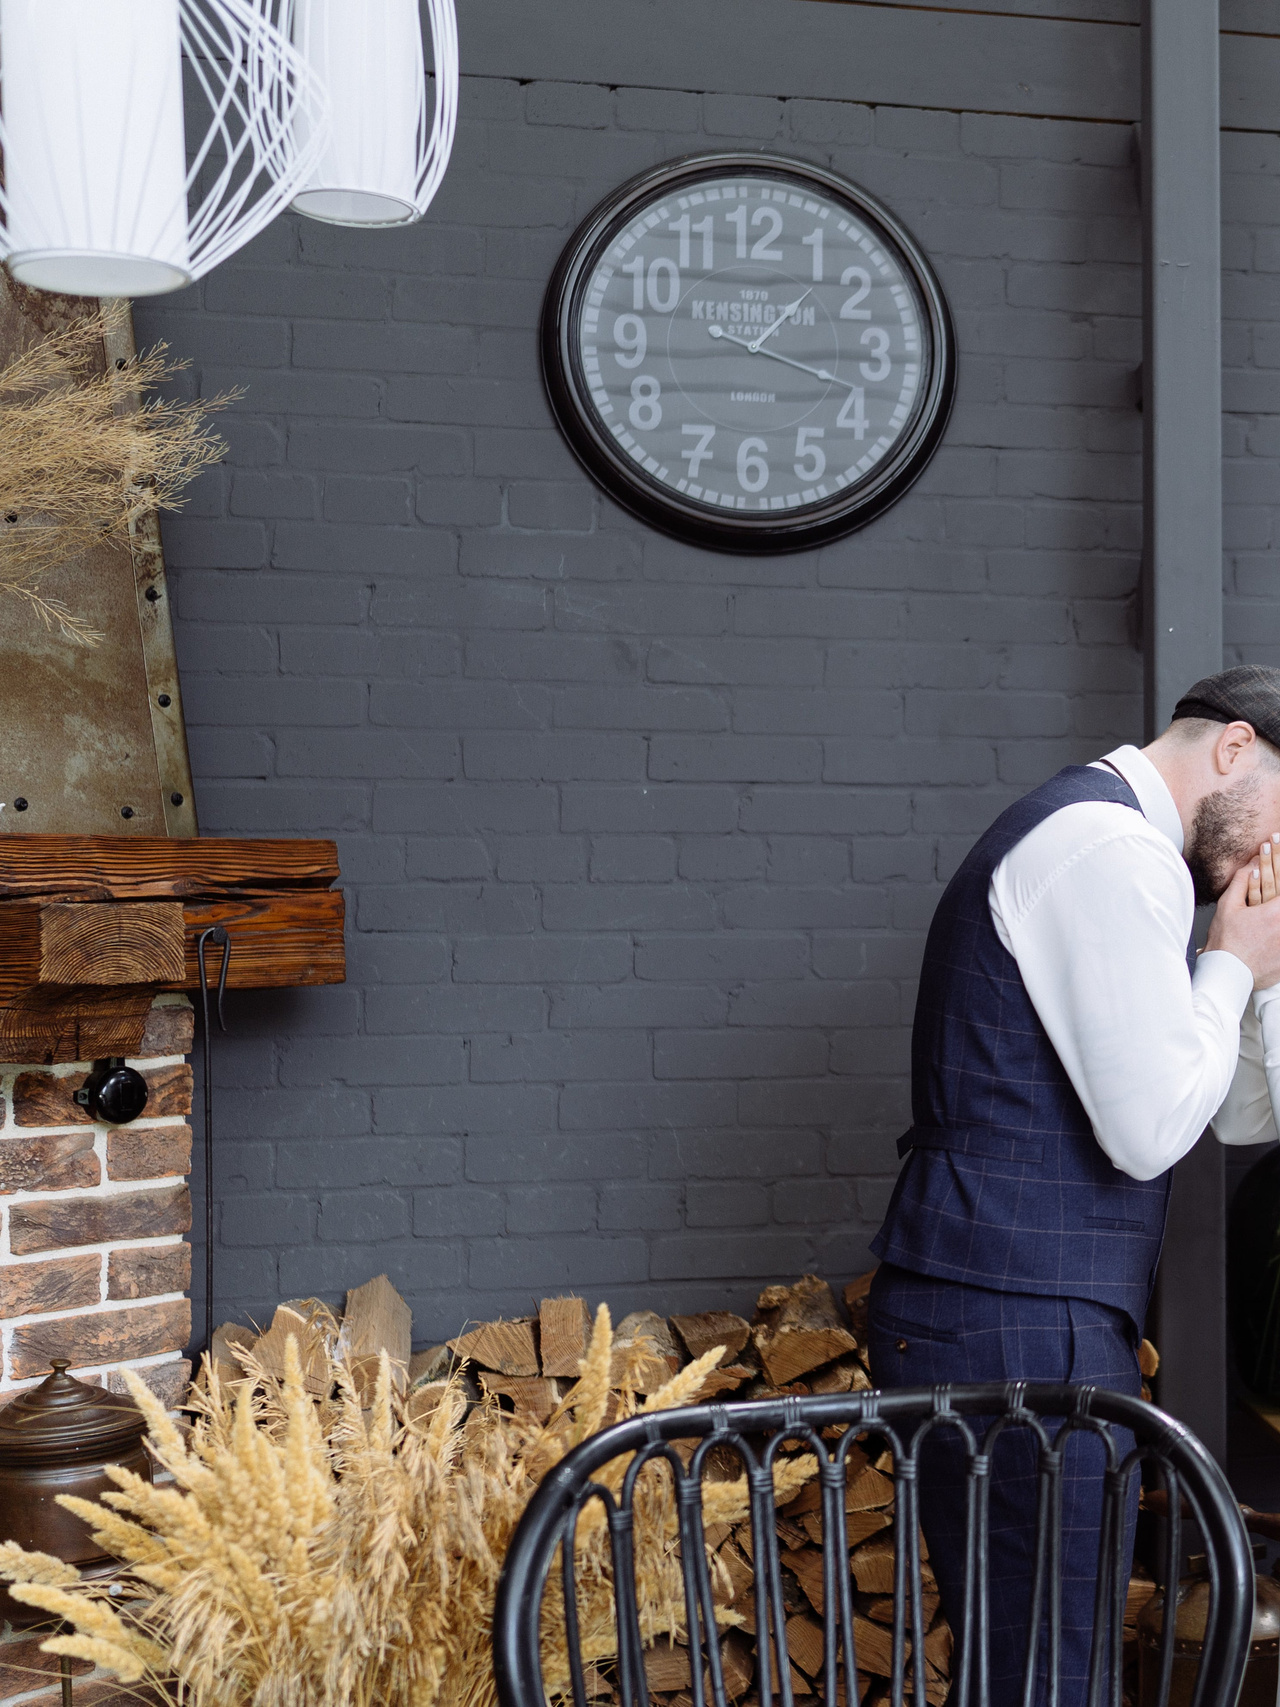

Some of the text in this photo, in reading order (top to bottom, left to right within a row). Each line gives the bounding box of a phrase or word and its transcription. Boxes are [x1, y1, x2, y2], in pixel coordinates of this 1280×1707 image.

[669, 213, 714, 270] 11
[724, 204, 784, 261] 12
[802, 228, 824, 282] 1
[622, 255, 681, 313] 10
[839, 266, 872, 321] 2
[613, 313, 647, 369] 9
[859, 327, 891, 382] 3
[628, 375, 662, 431] 8
[730, 391, 776, 403] LONDON
[836, 386, 869, 441] 4
[681, 423, 716, 478] 7
[736, 437, 769, 493] 6
[793, 427, 826, 482] 5
